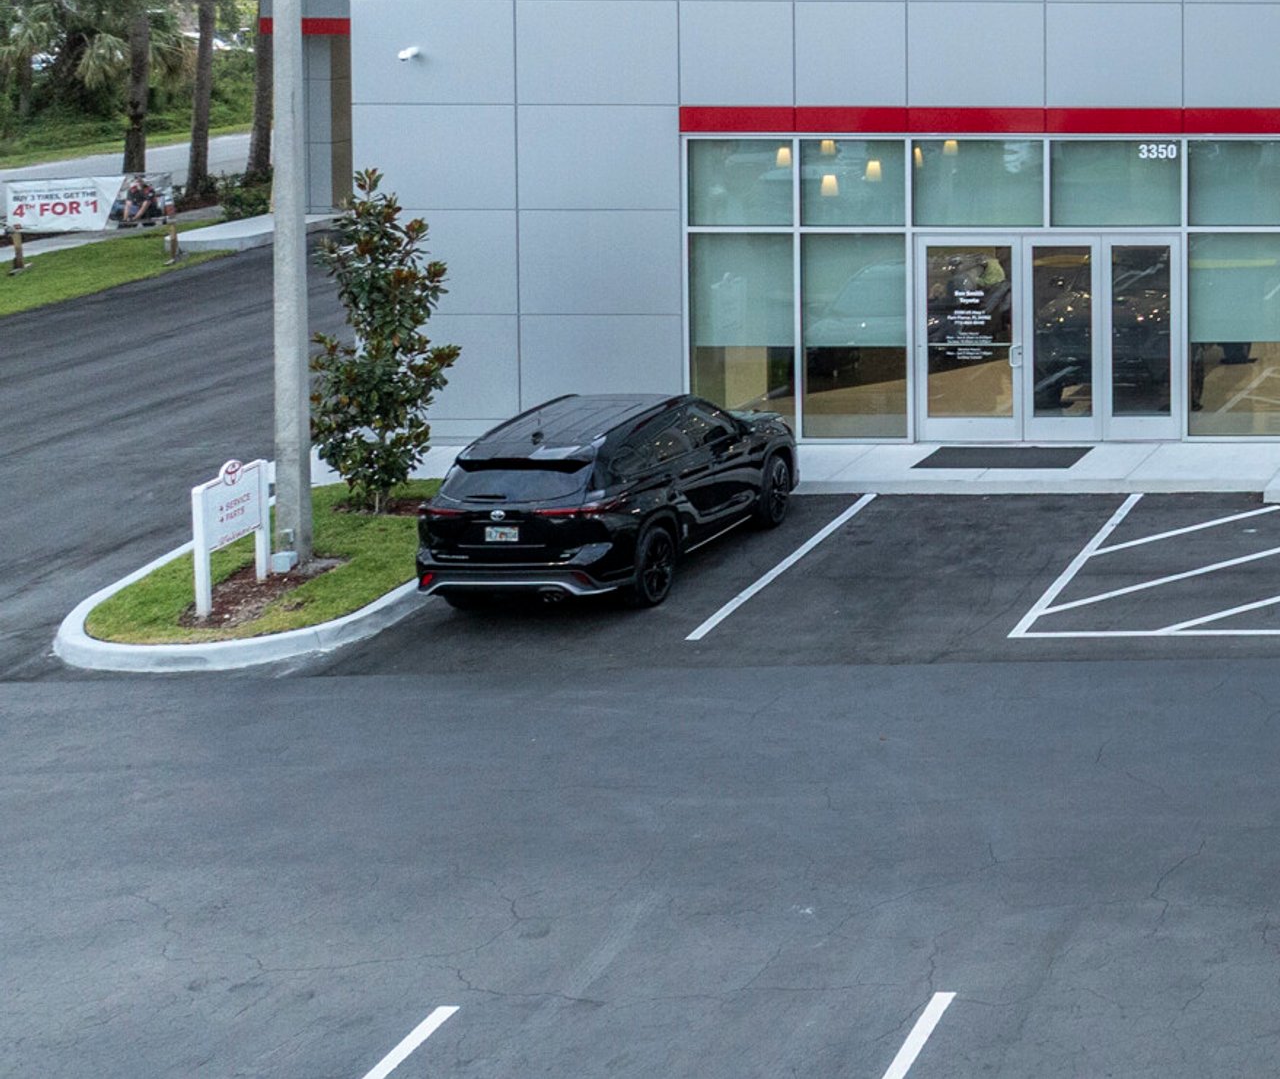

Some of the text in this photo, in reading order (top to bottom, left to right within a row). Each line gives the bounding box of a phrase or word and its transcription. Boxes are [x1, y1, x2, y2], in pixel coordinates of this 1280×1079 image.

[1138, 144, 1177, 159] 3350
[12, 194, 28, 202] BUY
[63, 191, 80, 199] GET
[82, 190, 97, 198] THE
[39, 201, 82, 216] FOR
